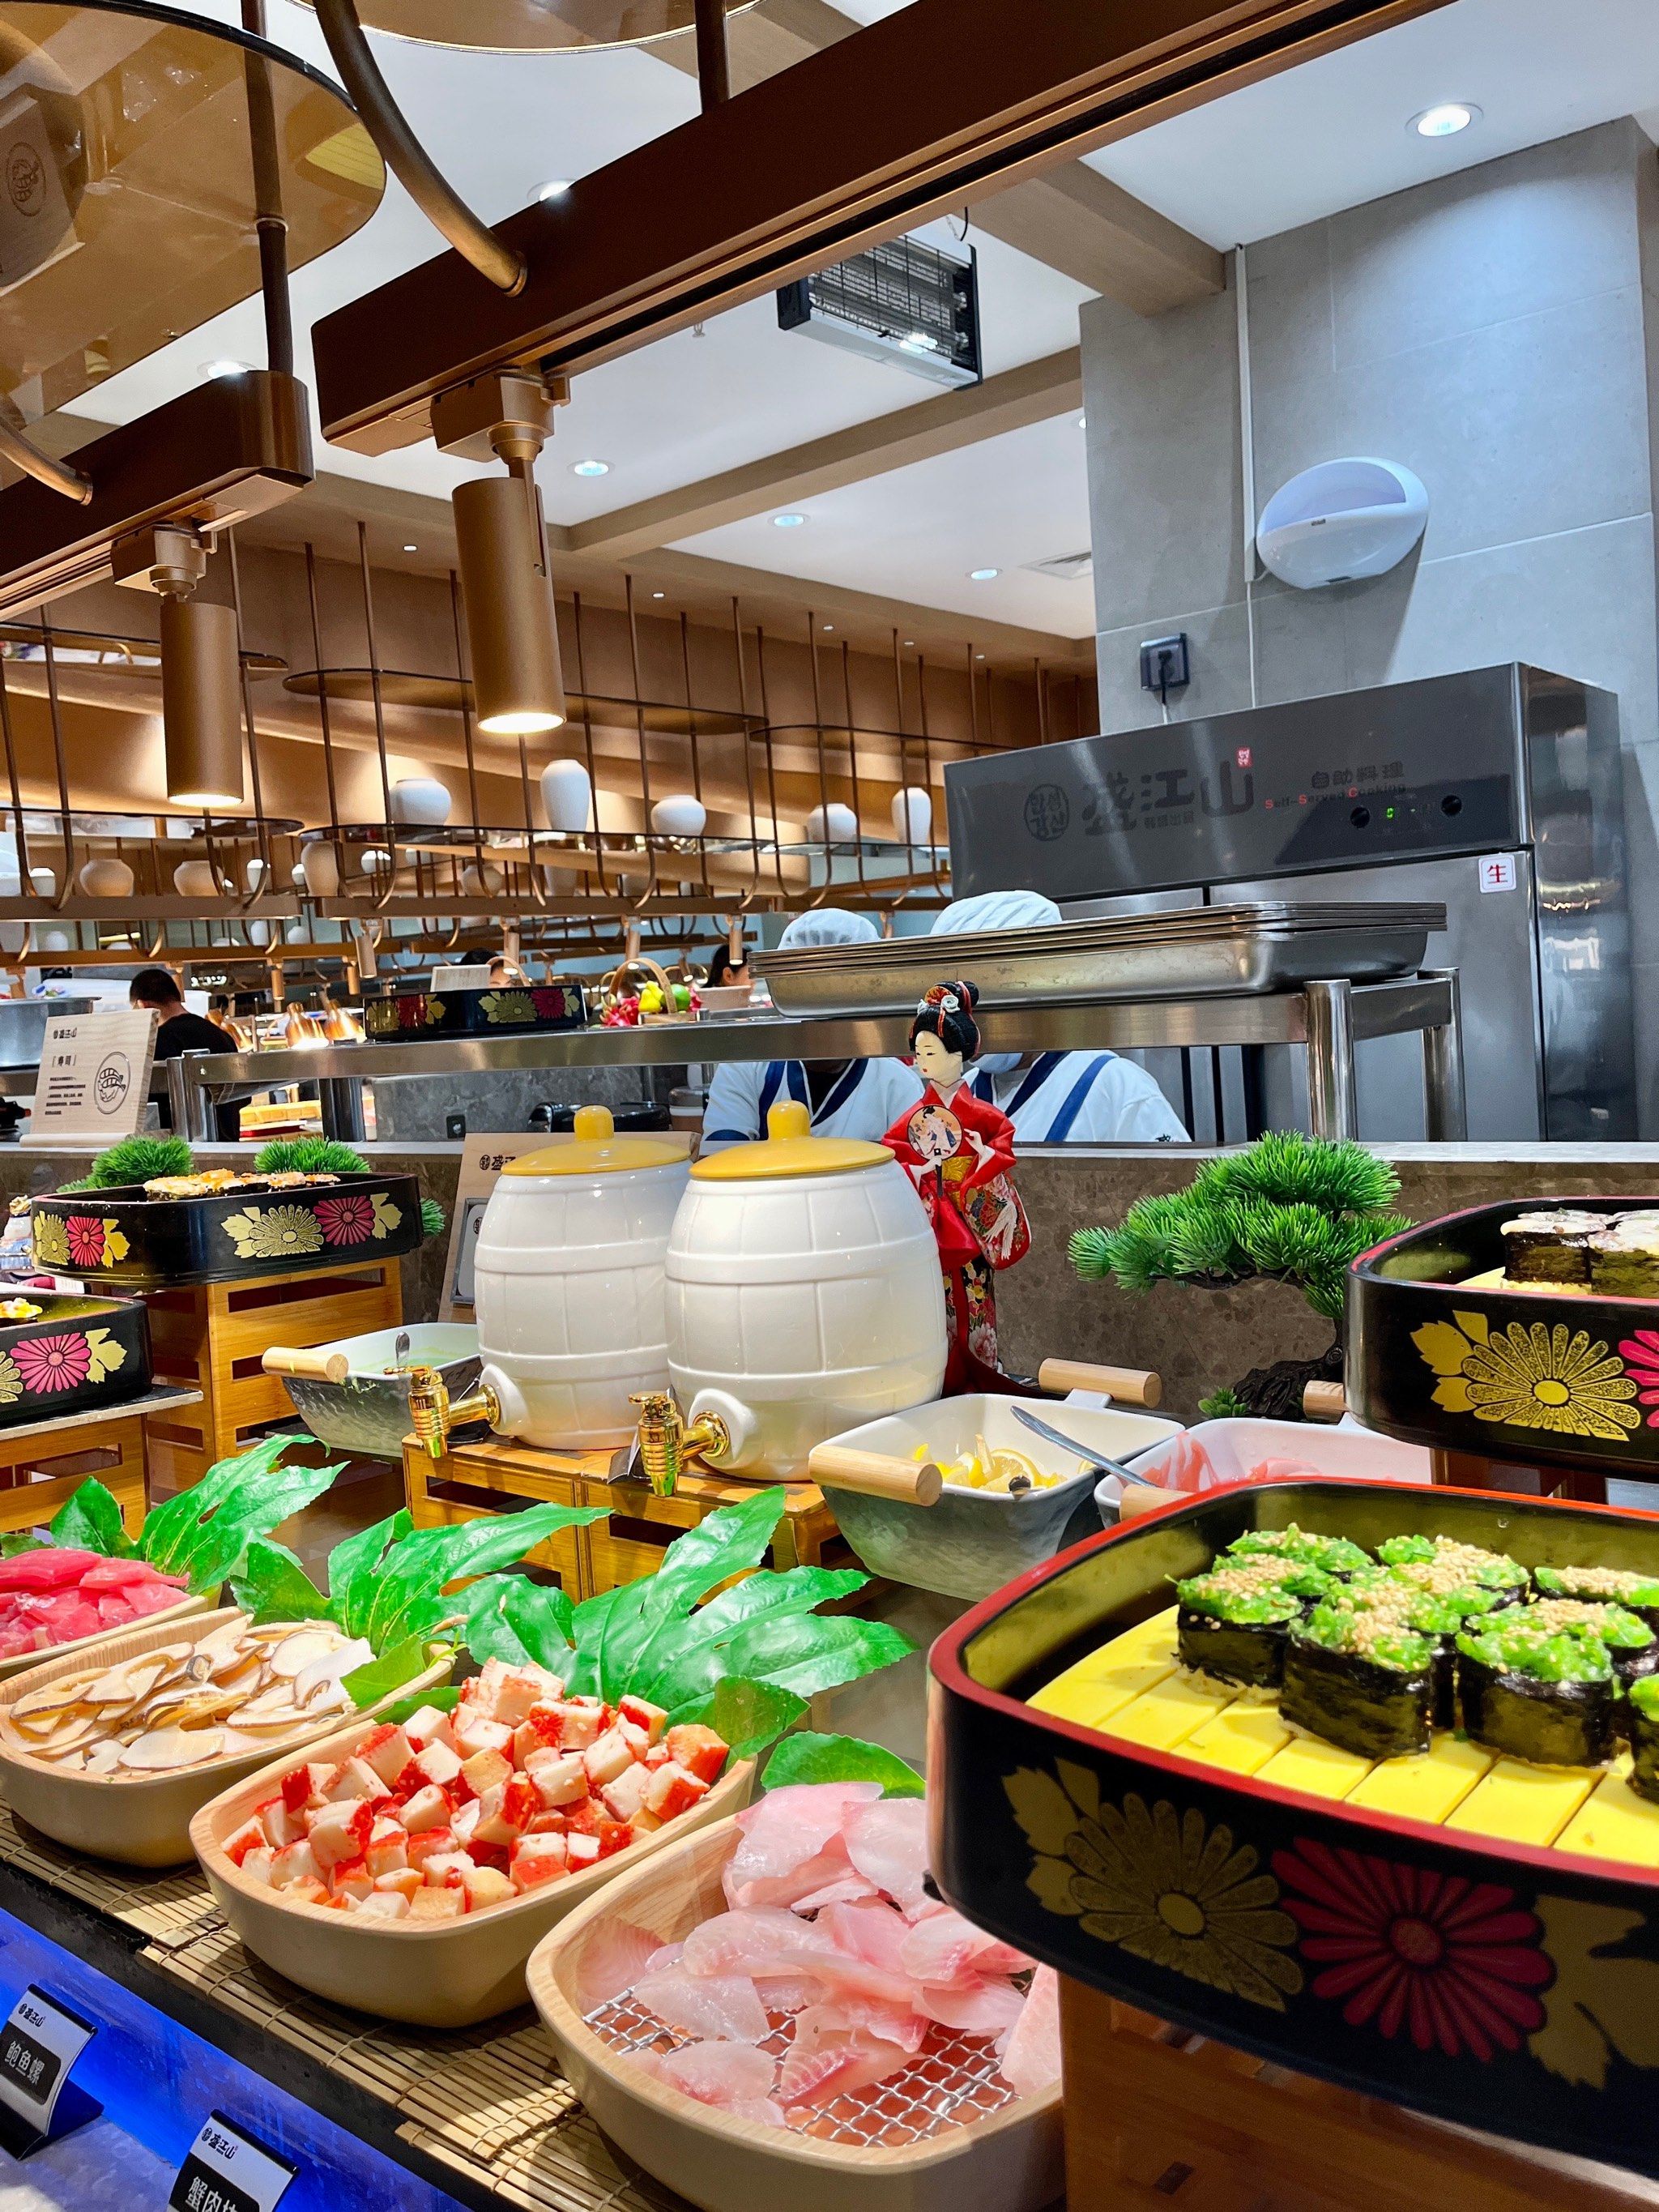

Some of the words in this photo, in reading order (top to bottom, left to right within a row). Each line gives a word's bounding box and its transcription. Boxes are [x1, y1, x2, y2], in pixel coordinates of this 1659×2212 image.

[1311, 760, 1405, 789] 自助料理
[1486, 864, 1508, 883] 生
[4, 2040, 45, 2085] 鲍鱼螺
[207, 2133, 236, 2159] 盛江山
